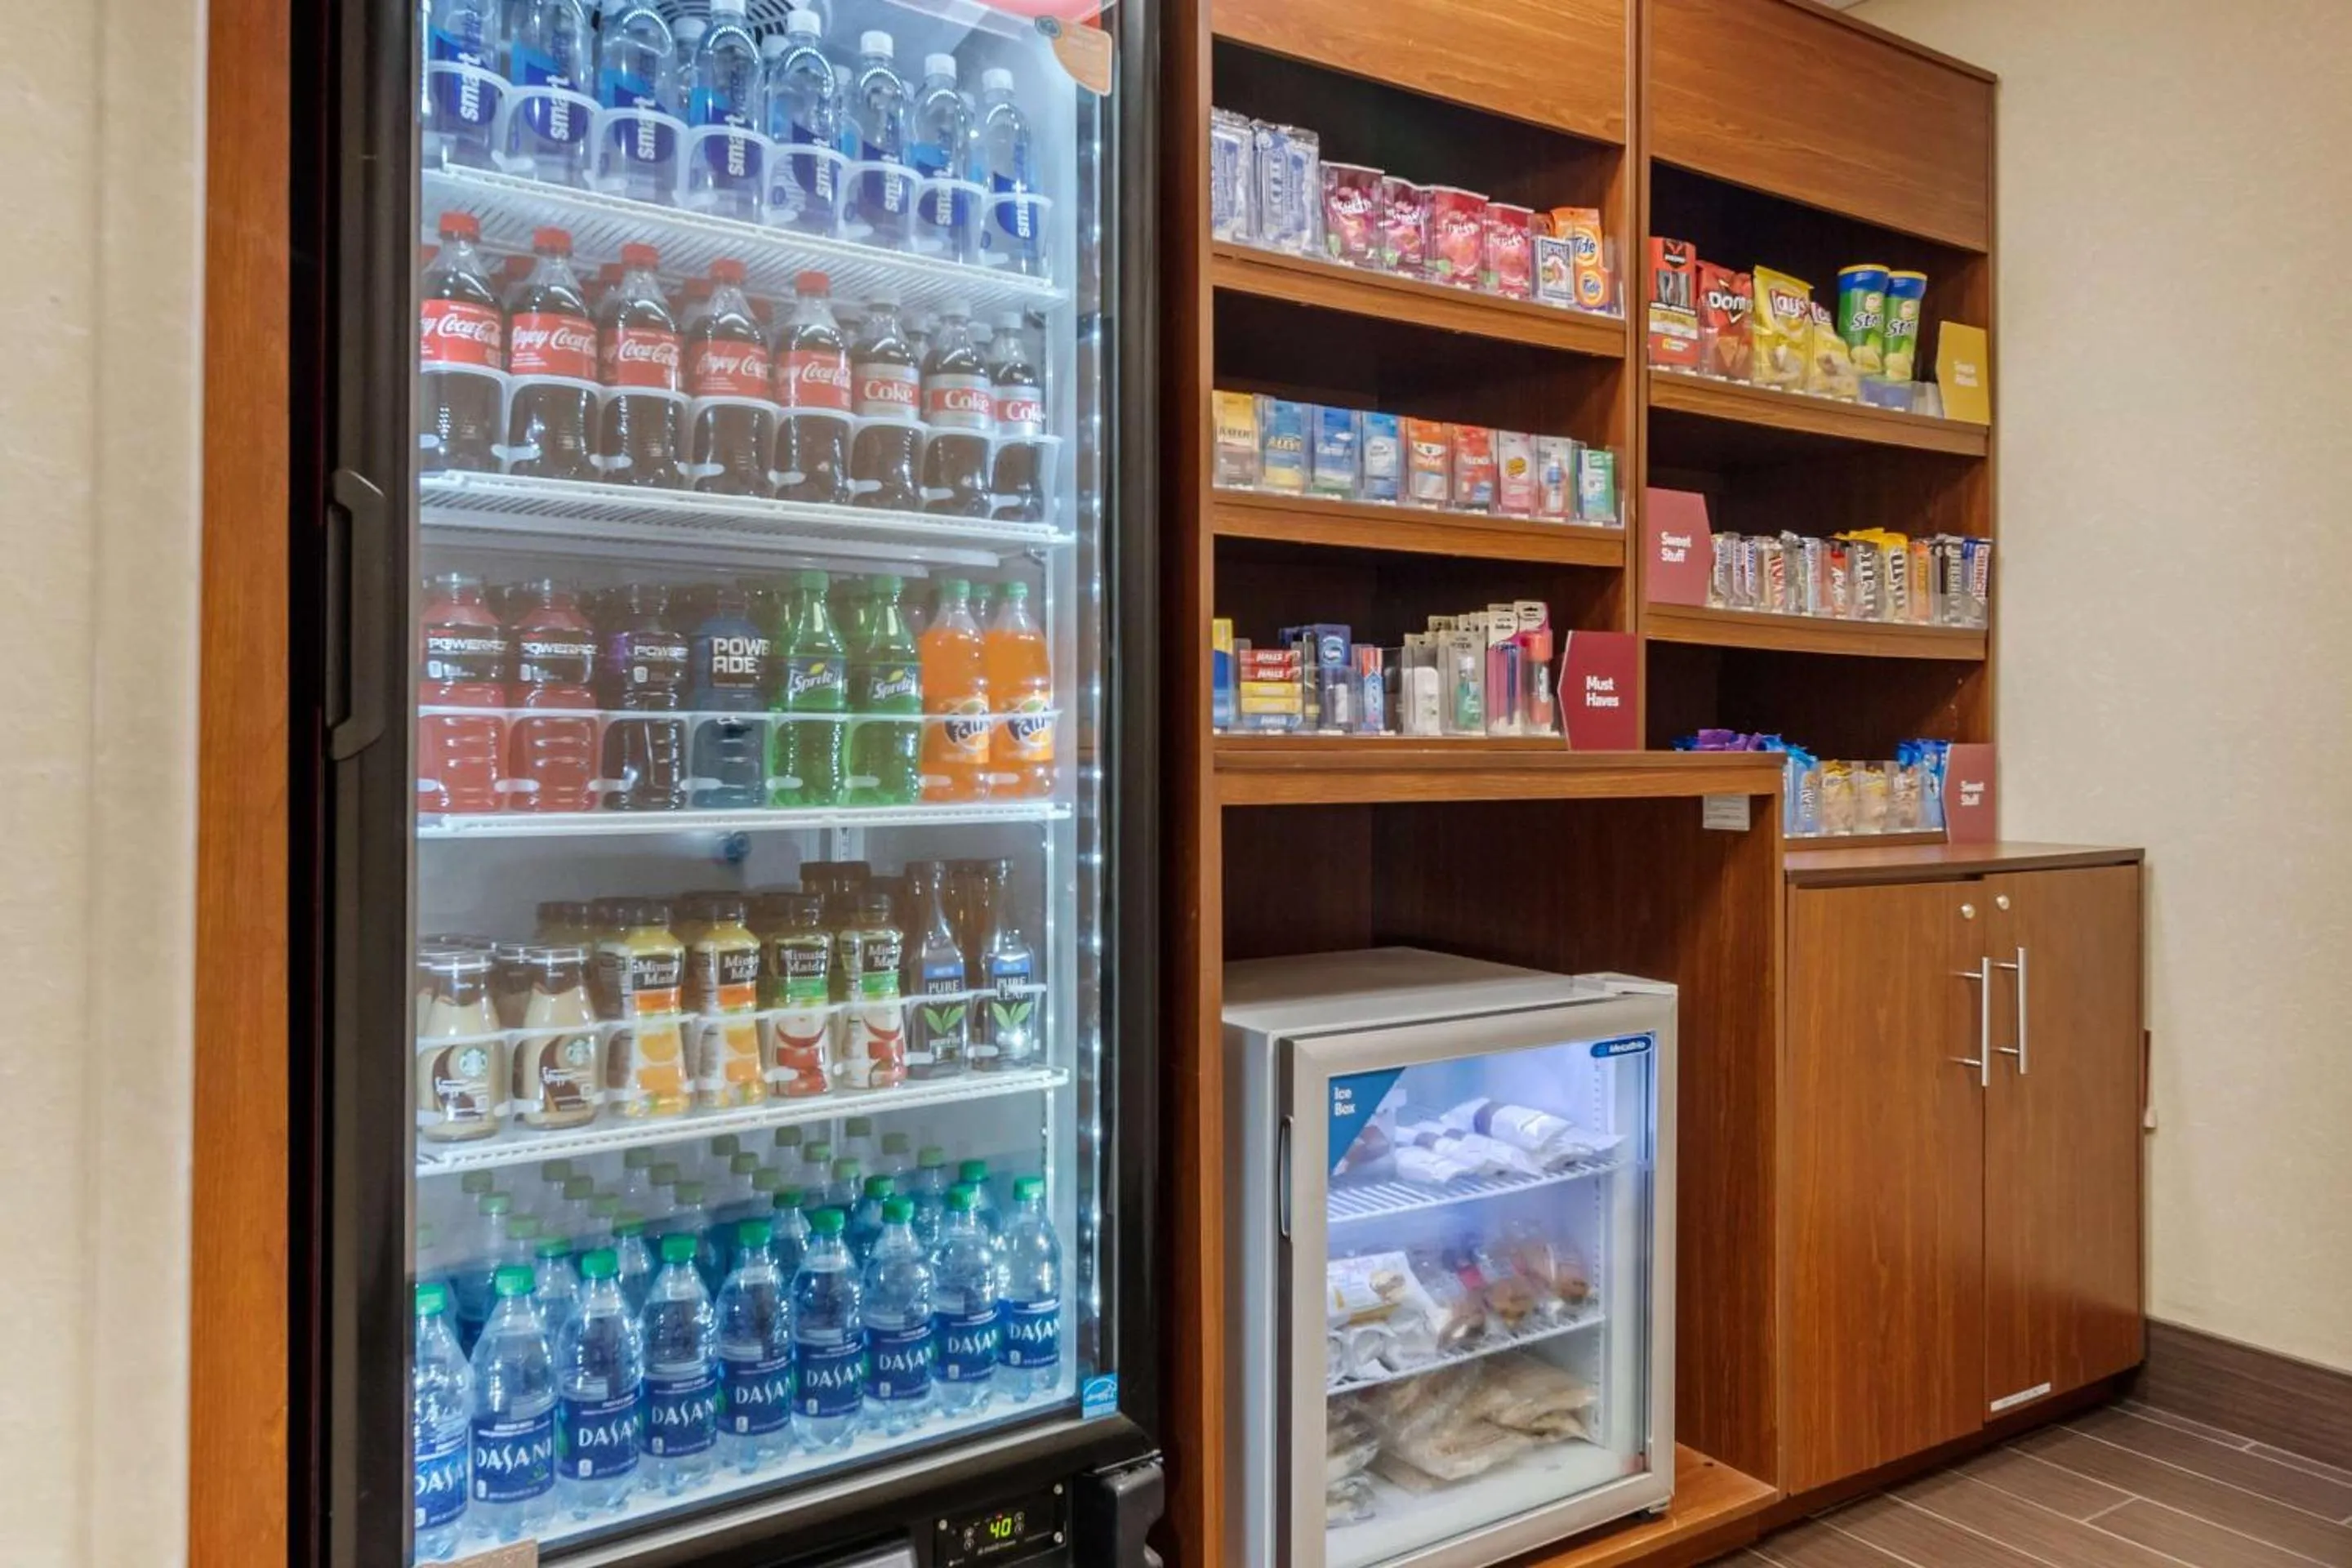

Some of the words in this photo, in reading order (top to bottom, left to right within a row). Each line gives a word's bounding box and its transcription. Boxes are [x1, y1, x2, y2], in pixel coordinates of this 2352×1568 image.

[634, 96, 656, 160] smat
[813, 138, 832, 202] smat
[881, 154, 900, 212] smat
[933, 163, 953, 226] smat
[1013, 179, 1031, 238] smat
[864, 381, 913, 403] Coke
[945, 390, 989, 412] Coke
[1661, 548, 1686, 563] Stuff
[428, 638, 508, 653] POWERAD
[713, 637, 771, 657] POWE
[1256, 653, 1283, 663] HALLS
[1257, 668, 1285, 679] HALLS
[1586, 676, 1615, 691] Must
[1586, 693, 1619, 707] Haves
[928, 980, 960, 995] PURE
[1334, 1087, 1352, 1100] Ice
[1334, 1102, 1356, 1116] Box
[1009, 1316, 1060, 1343] DASAN
[879, 1344, 932, 1371] DASAN
[806, 1362, 862, 1389] DASAN
[736, 1376, 791, 1405] DASAN
[652, 1398, 715, 1428] DASAN
[579, 1414, 640, 1447] DASAN
[476, 1436, 552, 1474] DASANI
[990, 1517, 1012, 1539] 40
